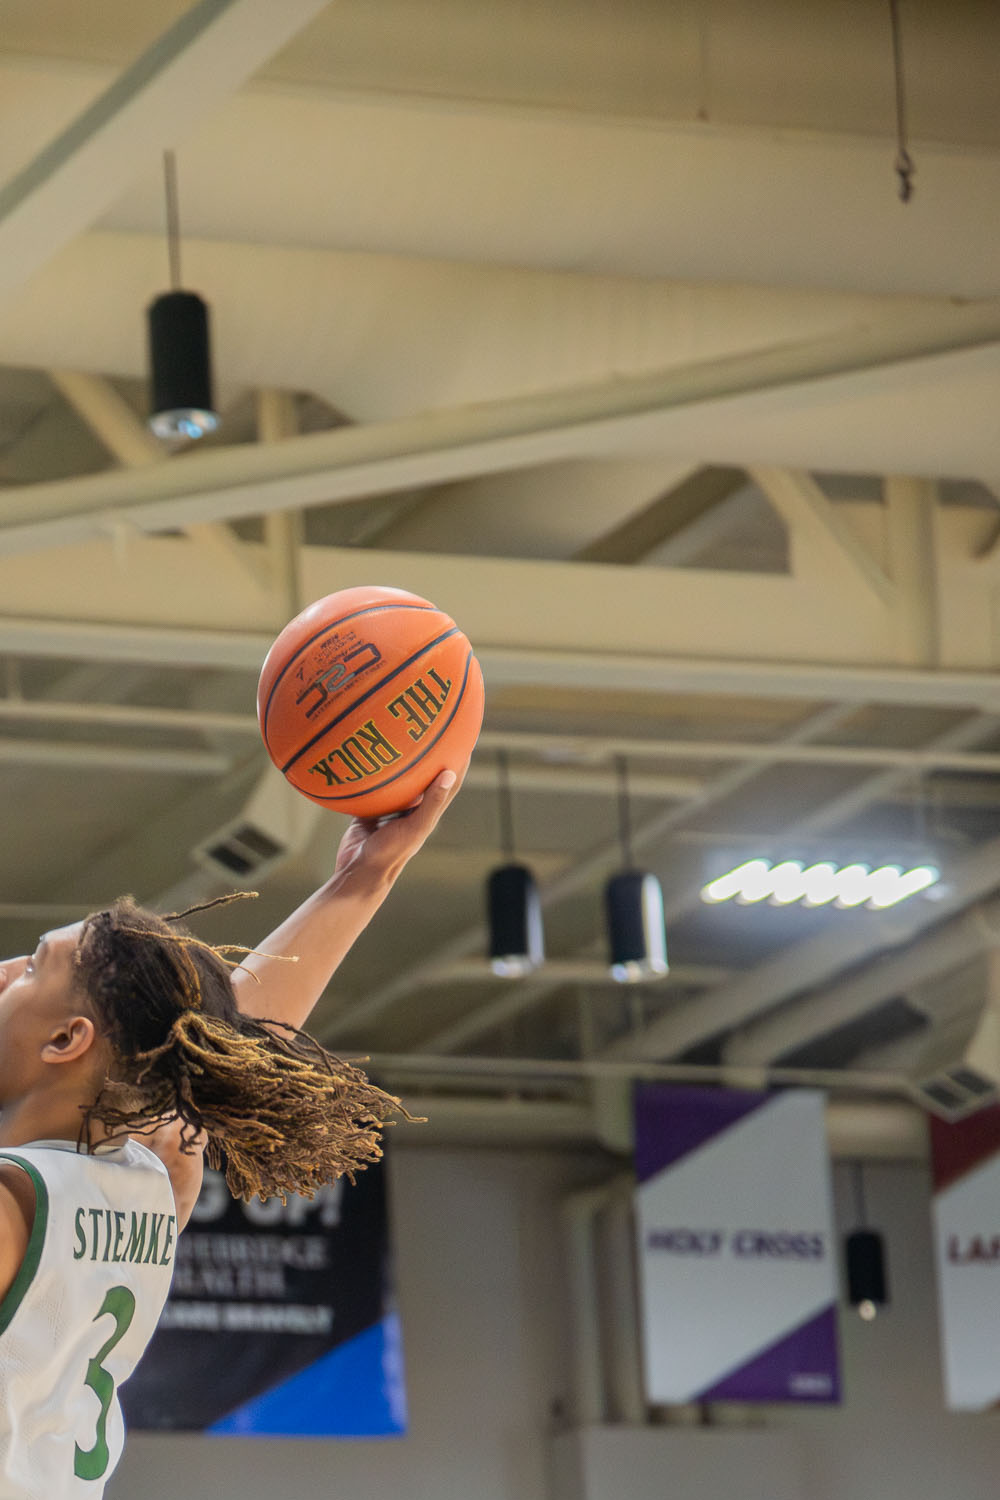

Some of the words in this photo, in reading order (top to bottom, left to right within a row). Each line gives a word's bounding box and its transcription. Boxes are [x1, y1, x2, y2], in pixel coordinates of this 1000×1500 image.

[386, 667, 452, 742] THE
[308, 719, 402, 787] ROCK
[73, 1207, 176, 1266] STIEMKE
[646, 1228, 722, 1260] HOLY
[731, 1230, 825, 1264] CROSS
[74, 1286, 135, 1481] 3
